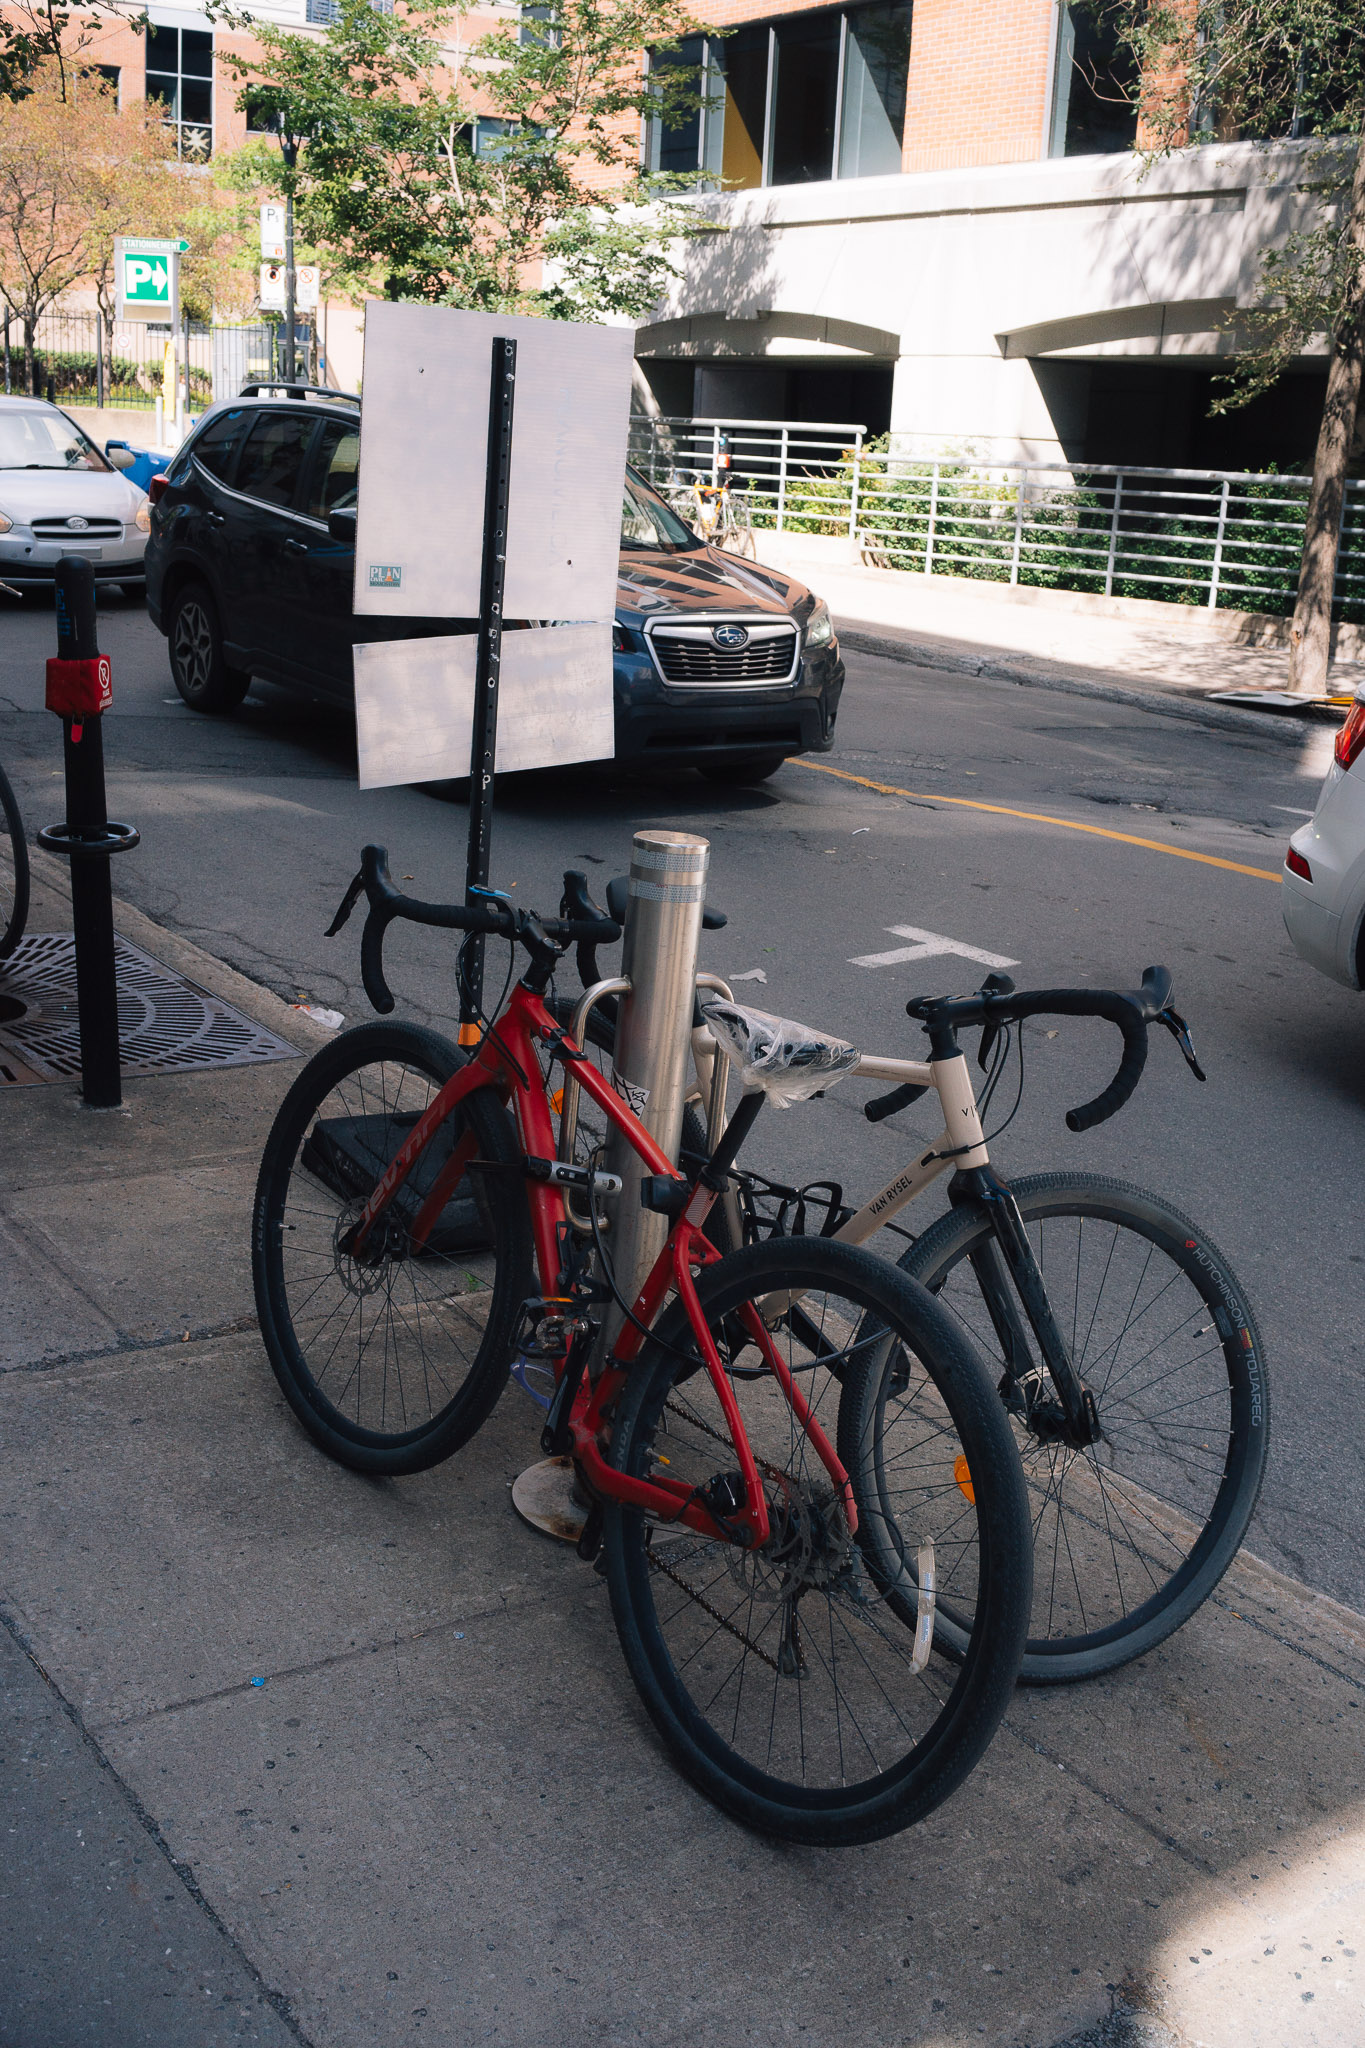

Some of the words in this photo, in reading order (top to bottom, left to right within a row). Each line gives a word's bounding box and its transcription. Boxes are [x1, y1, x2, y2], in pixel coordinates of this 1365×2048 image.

[121, 239, 181, 250] STATIONNEMENT
[126, 260, 152, 293] P
[869, 1197, 888, 1215] VAN
[886, 1175, 912, 1201] RYSEL
[257, 1196, 266, 1251] KENDA
[1192, 1247, 1246, 1328] HUTCHINSON
[1245, 1350, 1262, 1427] TOUAREG
[615, 1421, 631, 1471] ENDA
